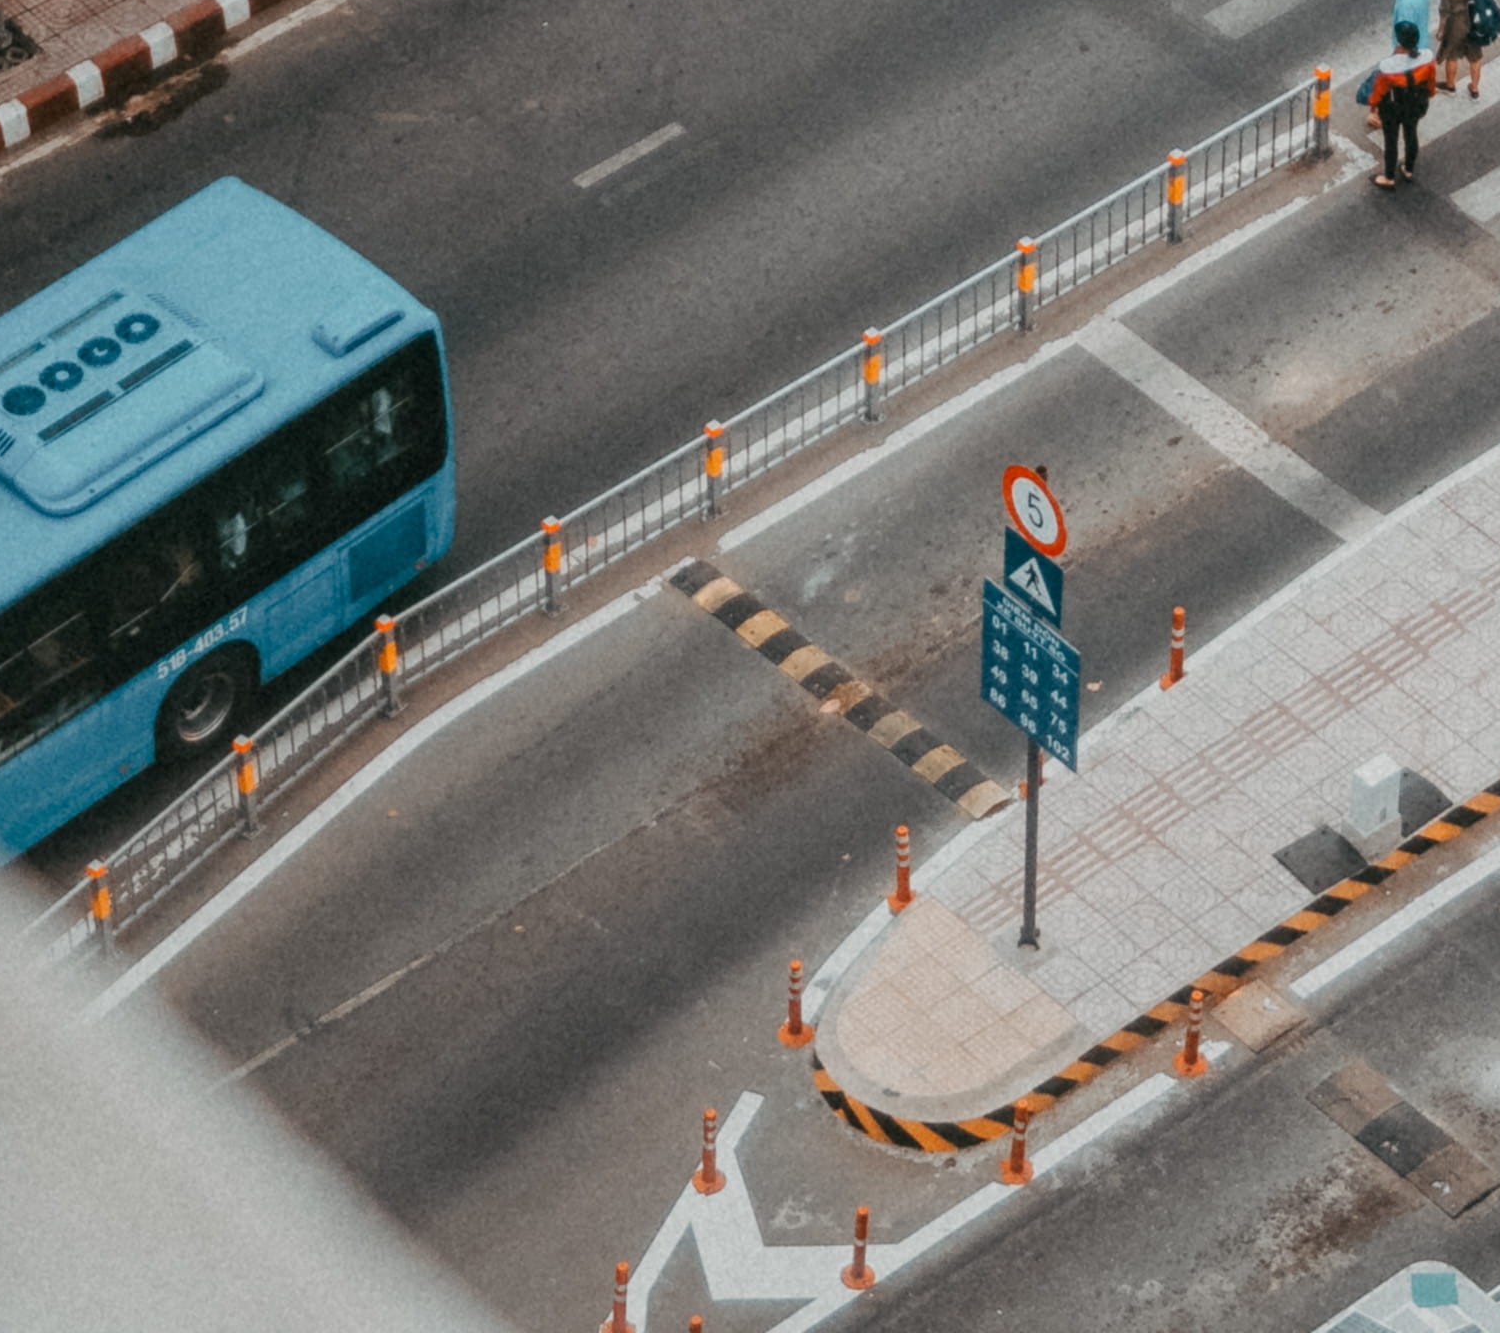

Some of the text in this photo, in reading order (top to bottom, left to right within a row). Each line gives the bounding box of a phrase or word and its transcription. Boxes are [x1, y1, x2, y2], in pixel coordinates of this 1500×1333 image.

[1028, 491, 1044, 529] 5
[992, 614, 1008, 636] 01
[1023, 641, 1037, 660] 11
[1052, 663, 1069, 685] 34
[1051, 690, 1067, 709] 44
[1051, 711, 1067, 734] 75
[1046, 734, 1070, 762] 102
